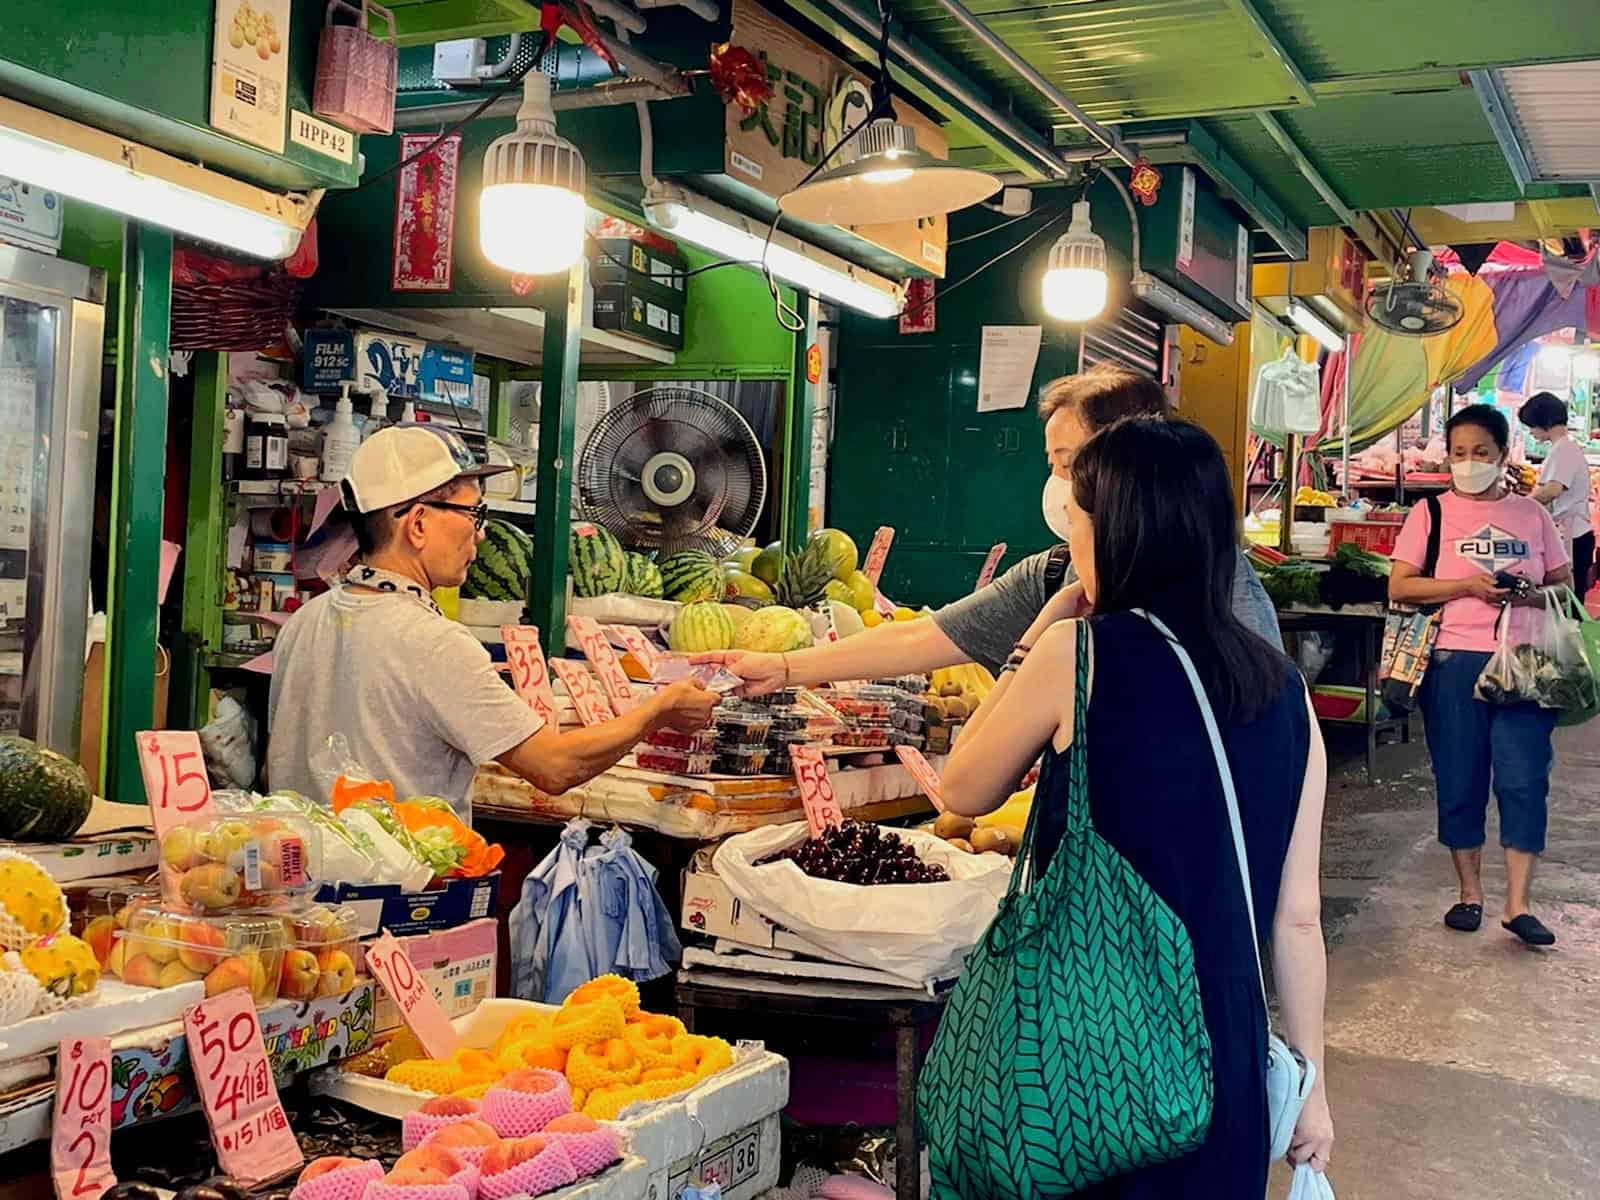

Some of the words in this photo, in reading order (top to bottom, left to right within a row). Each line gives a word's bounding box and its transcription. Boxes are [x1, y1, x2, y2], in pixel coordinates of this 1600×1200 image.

[299, 119, 346, 153] HPP42
[315, 343, 345, 355] FILM
[1460, 542, 1526, 555] FUBU
[515, 645, 545, 688] 35
[566, 671, 596, 698] 32
[160, 751, 209, 812] 15
[800, 761, 833, 800] 58
[281, 842, 292, 882] WORKS
[292, 845, 302, 875] FRUIT
[383, 951, 414, 1003] 10
[199, 1011, 255, 1081] 50
[62, 1060, 109, 1115] 10
[68, 1130, 102, 1197] 2
[736, 1142, 756, 1174] 36
